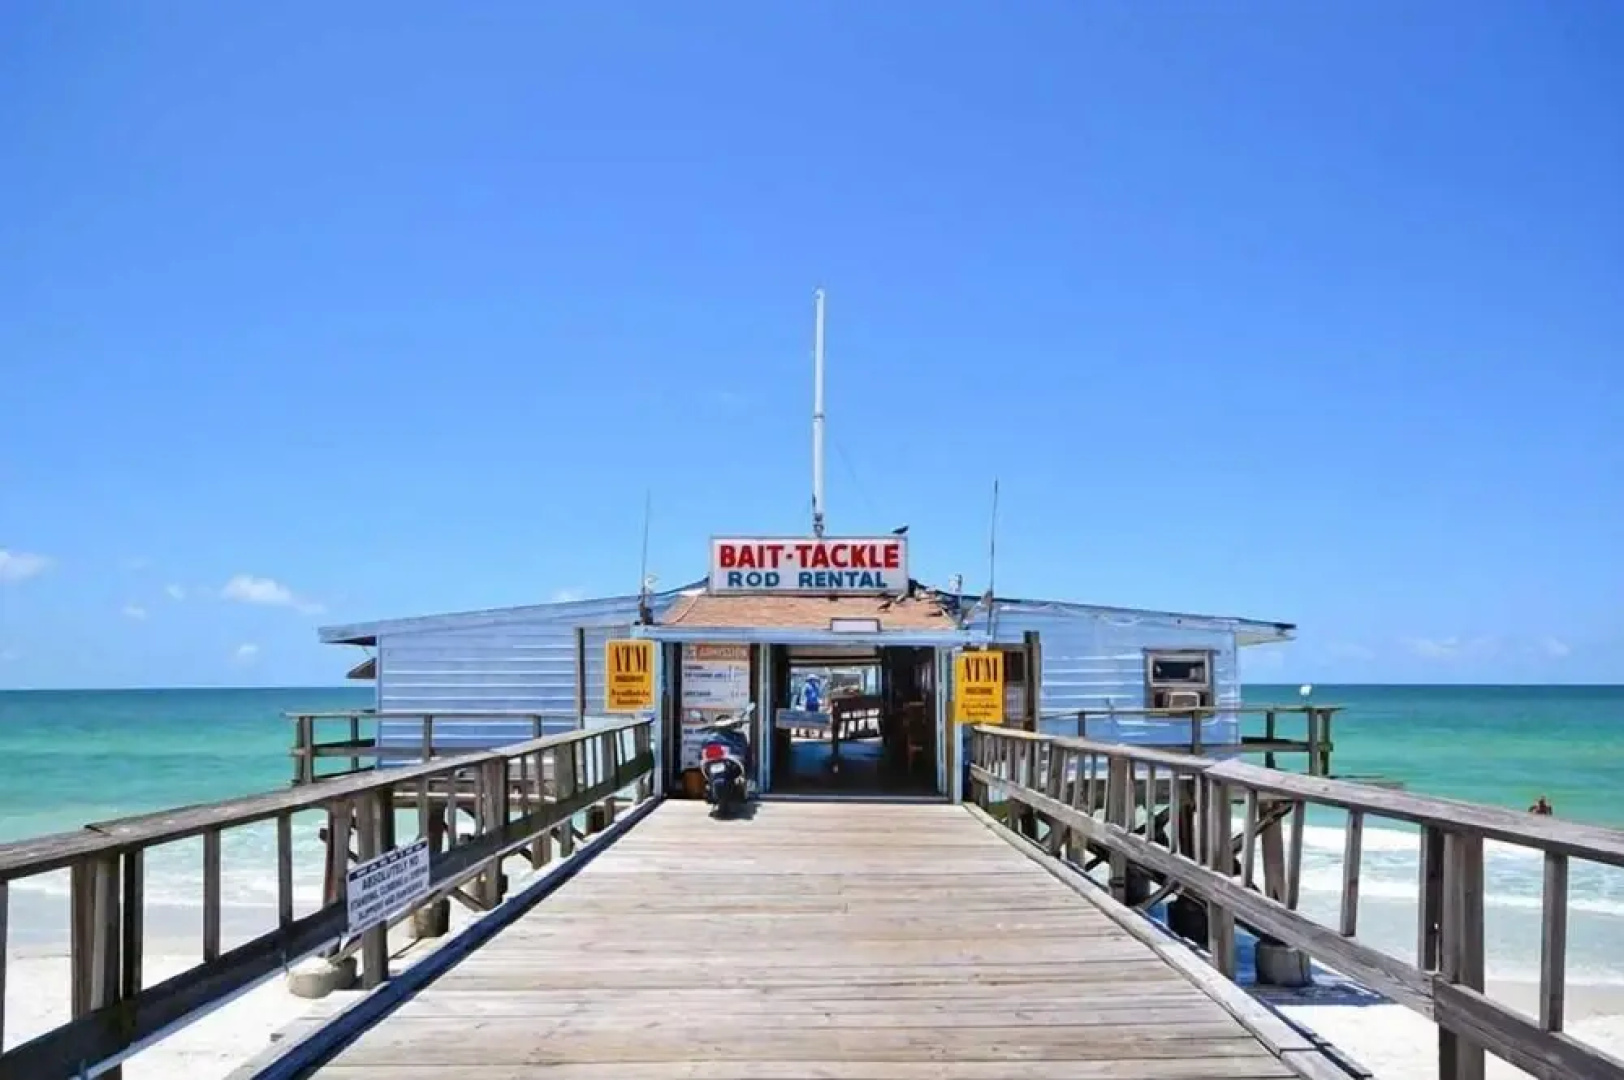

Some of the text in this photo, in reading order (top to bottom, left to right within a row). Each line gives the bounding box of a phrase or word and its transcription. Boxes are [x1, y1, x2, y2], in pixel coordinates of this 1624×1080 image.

[728, 571, 888, 588] ROD RENTAL
[612, 645, 649, 673] ATM
[961, 656, 998, 683] ATM
